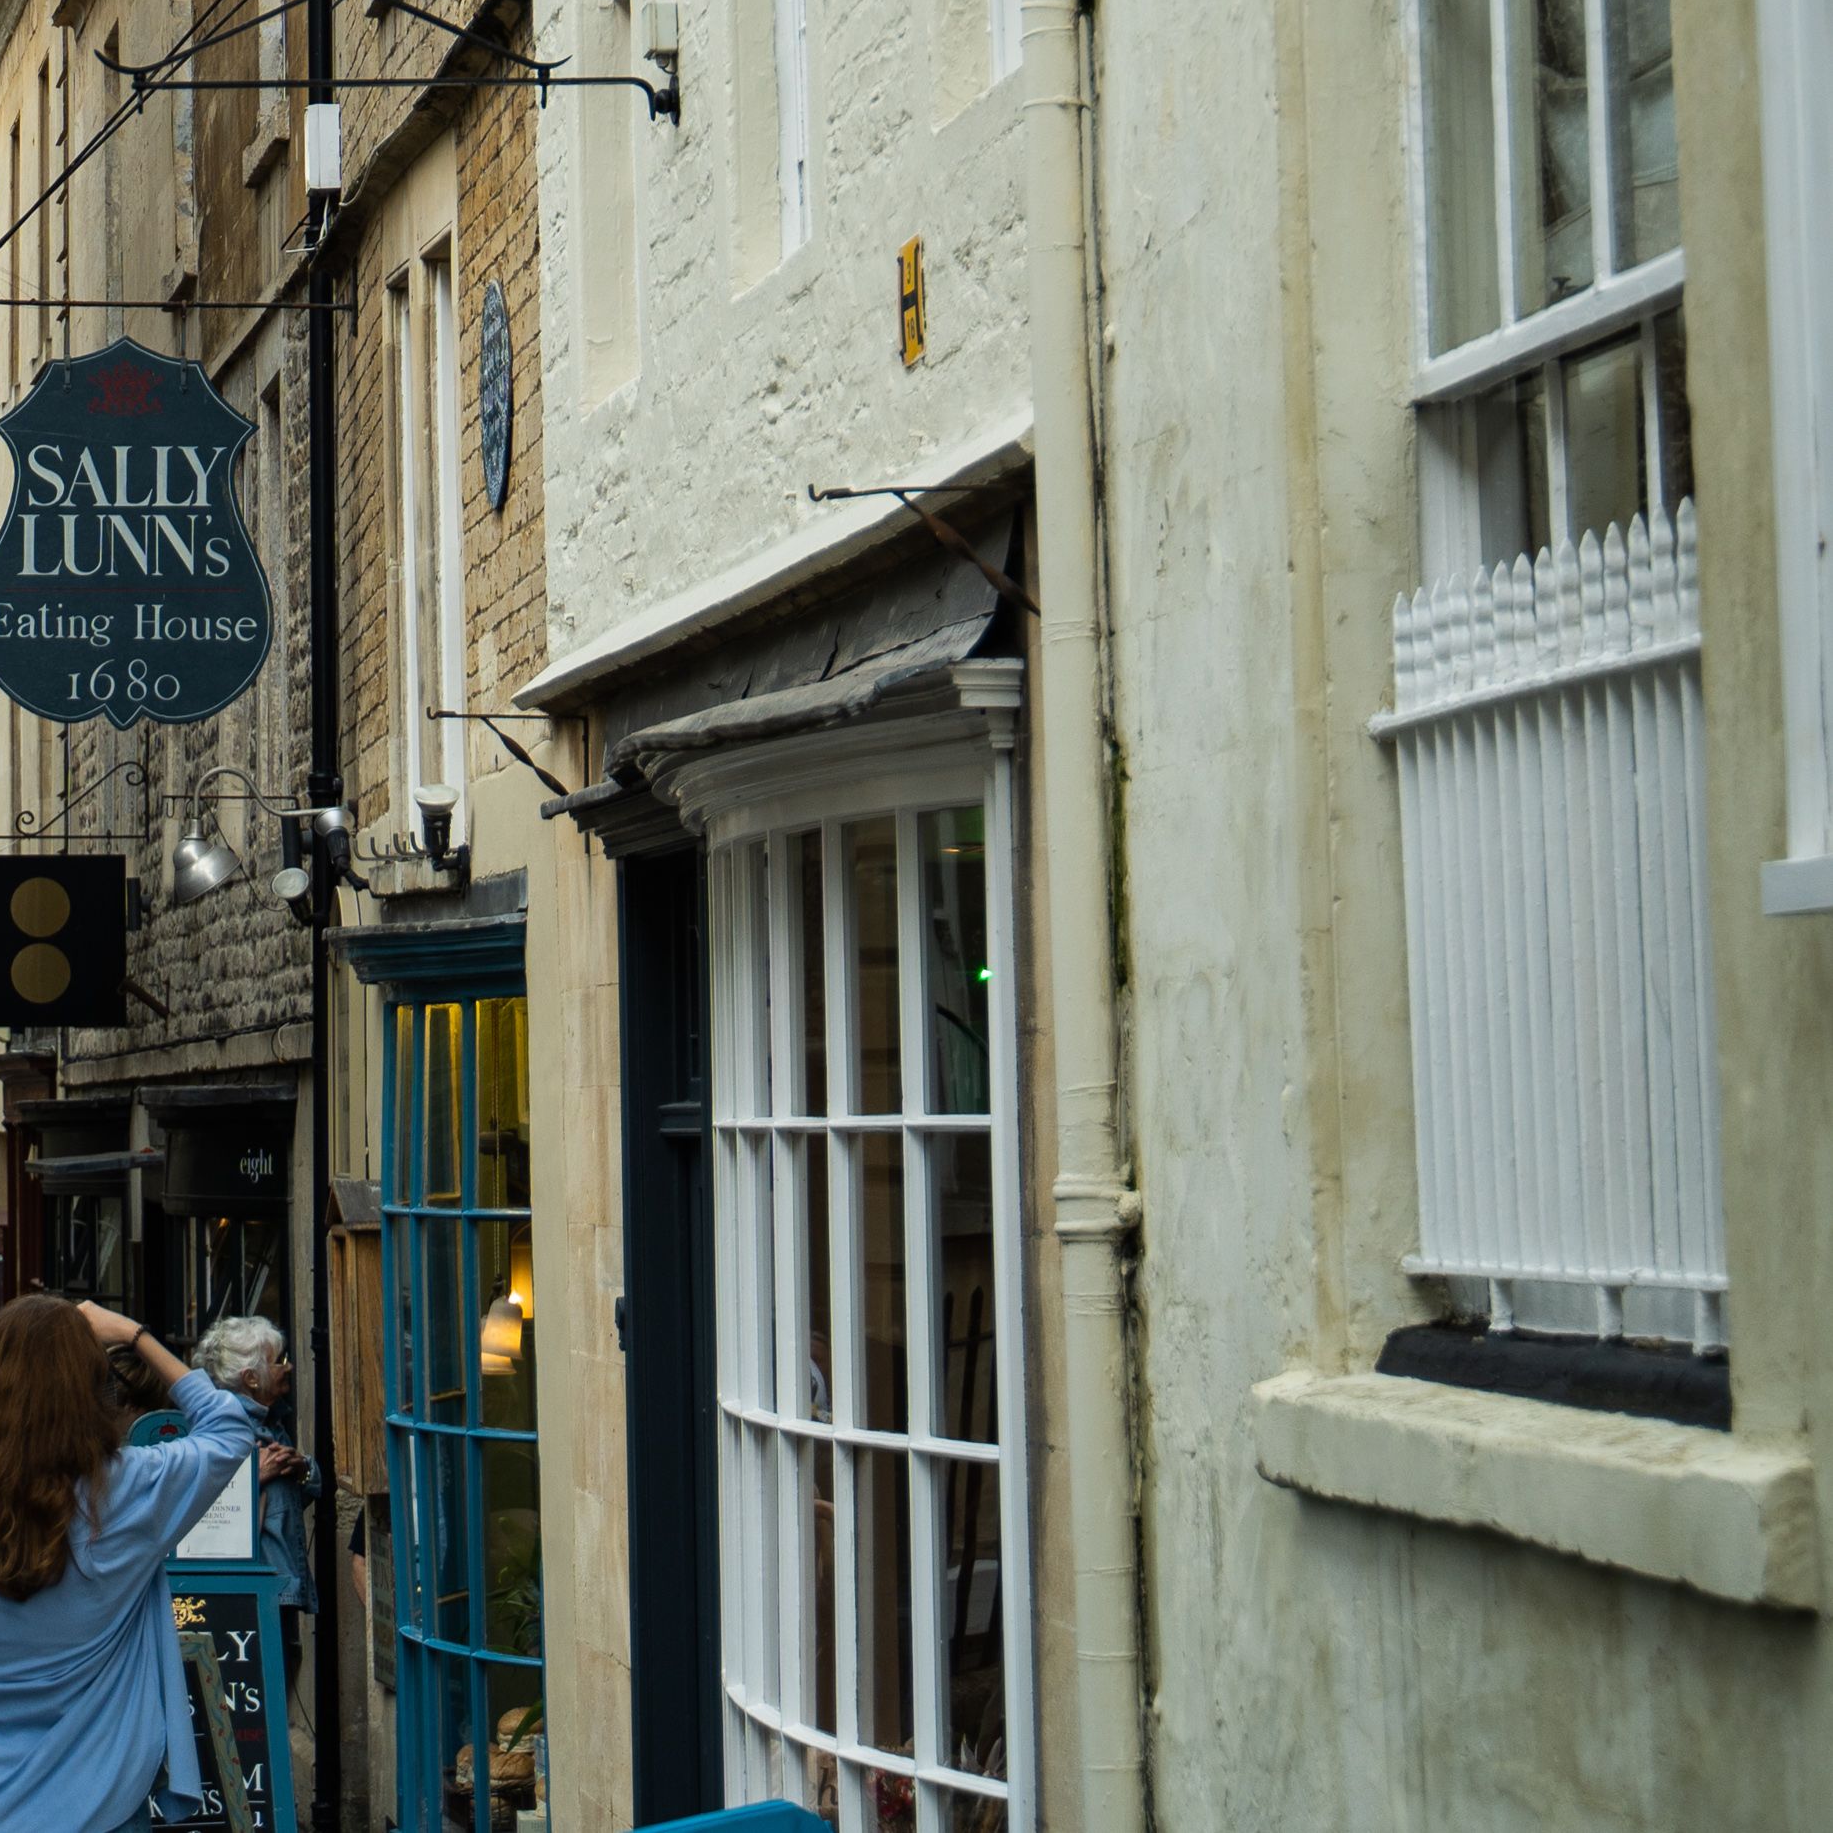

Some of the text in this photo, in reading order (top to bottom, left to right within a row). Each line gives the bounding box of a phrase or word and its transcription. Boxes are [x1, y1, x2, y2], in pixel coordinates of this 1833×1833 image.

[27, 444, 227, 508] SALLY
[133, 602, 259, 643] House
[66, 658, 182, 702] 1680
[239, 1148, 274, 1183] eight
